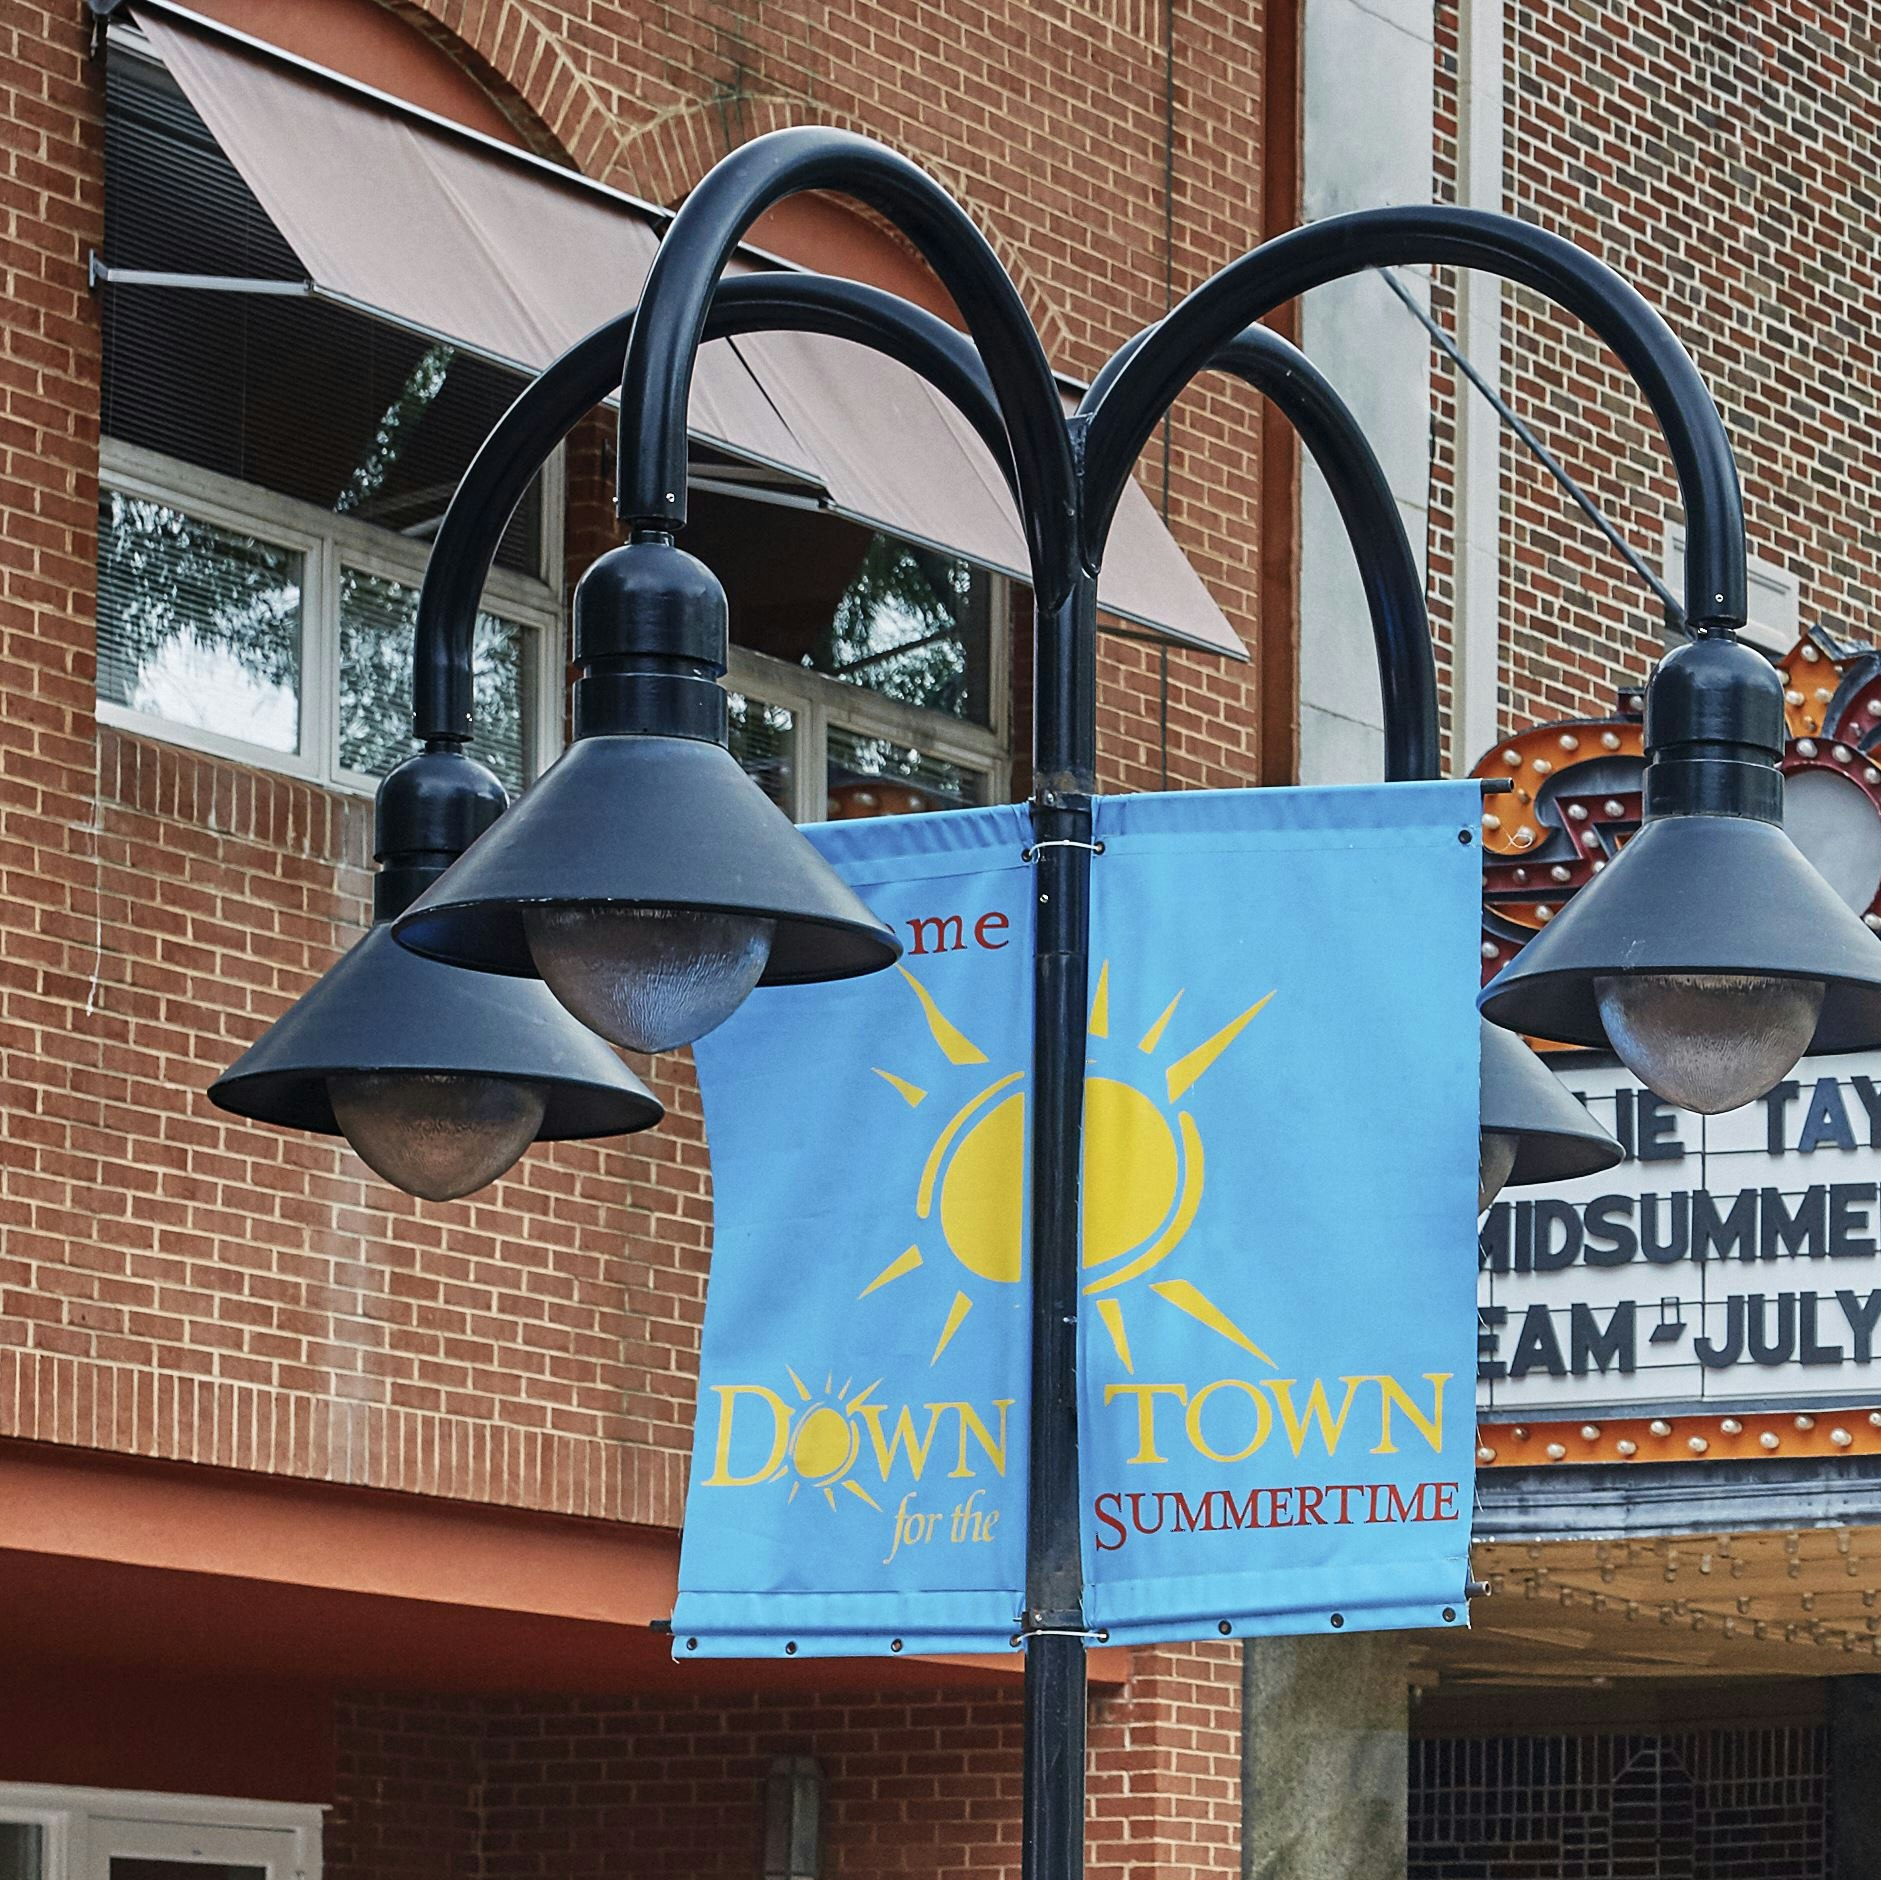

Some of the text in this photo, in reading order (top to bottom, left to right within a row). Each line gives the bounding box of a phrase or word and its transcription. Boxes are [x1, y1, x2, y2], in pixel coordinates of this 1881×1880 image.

[885, 911, 1009, 956] me
[1103, 1371, 1455, 1466] TOWN
[883, 1488, 1001, 1565] for the
[1095, 1481, 1461, 1552] SUMMERTIME
